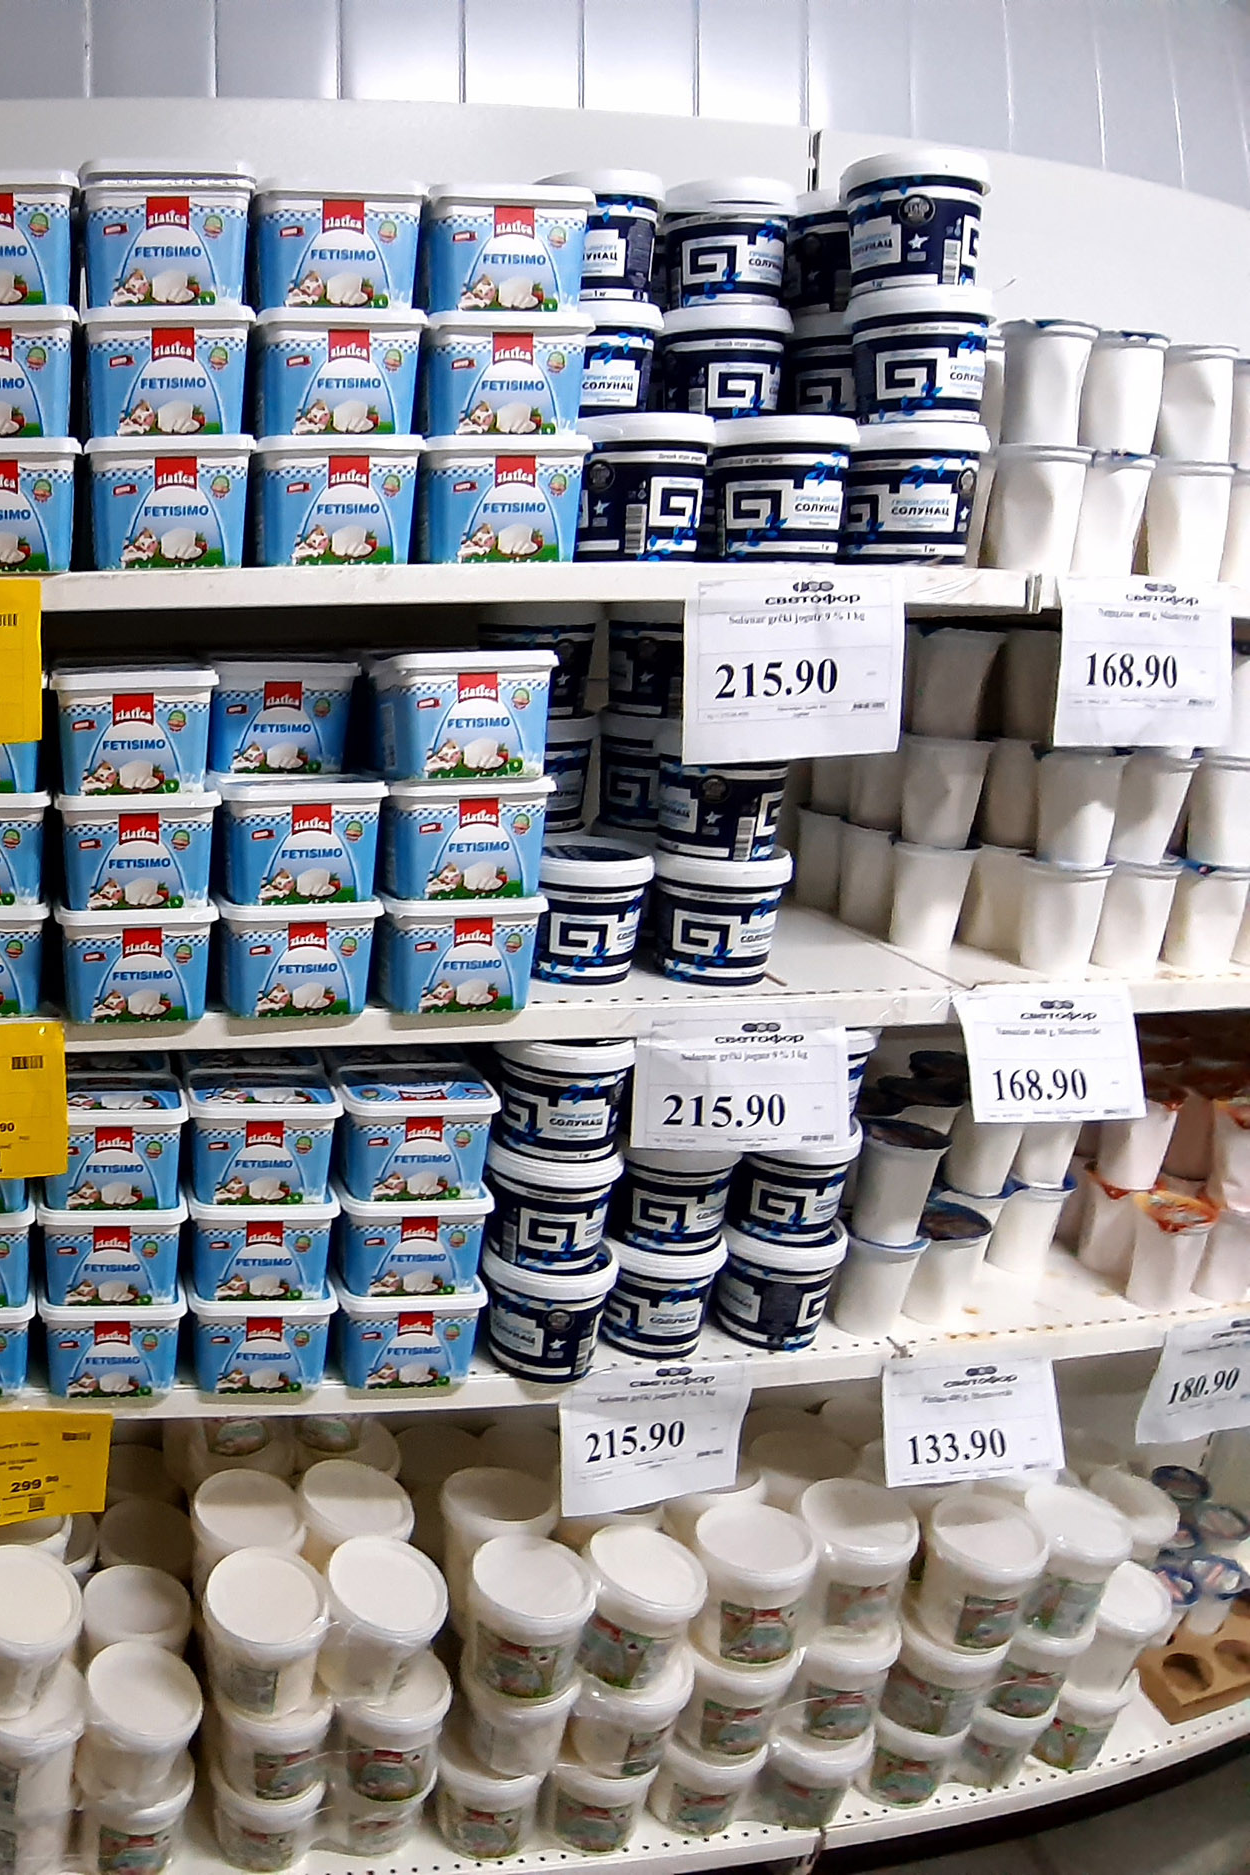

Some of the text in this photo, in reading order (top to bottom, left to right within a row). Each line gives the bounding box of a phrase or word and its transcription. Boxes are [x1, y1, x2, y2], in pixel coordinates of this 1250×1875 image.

[148, 209, 188, 226] zlatica
[324, 212, 364, 229] zlatica
[495, 219, 534, 236] zlatica
[133, 246, 201, 258] FETISIMO
[311, 249, 376, 261] FETISIMO
[583, 252, 617, 261] УНАЦ
[483, 254, 546, 265] FETISIMO
[153, 340, 193, 358] zlatica
[330, 342, 369, 358] zlatica
[494, 344, 532, 360] zlatica
[140, 378, 206, 389] FETISIMO
[317, 378, 381, 389] FETISIMO
[481, 380, 544, 391] FETISIMO
[582, 380, 634, 391] СОЛУНАЦ
[157, 469, 196, 486] zlatica
[330, 468, 368, 484] zlatica
[496, 468, 535, 485] zlatica
[144, 505, 209, 517] FETISIMO
[317, 504, 379, 515] FETISIMO
[483, 503, 546, 513] FETISIMO
[891, 506, 950, 517] СОЛУНАЦ
[1086, 652, 1178, 688] 168.90
[715, 658, 838, 700] 215.90
[459, 685, 497, 700] zlatica
[265, 693, 300, 708] zlatica
[115, 706, 152, 721] zlatica
[253, 724, 311, 733] FETISIMO
[447, 717, 510, 728] FETISIMO
[103, 739, 165, 750] FETISIMO
[294, 817, 330, 831] zlatica
[461, 811, 498, 825] zlatica
[120, 825, 158, 841] zlatica
[449, 841, 509, 853] FETISIMO
[281, 848, 342, 859] FETISIMO
[109, 858, 170, 869] FETISIMO
[290, 934, 325, 947] zlatica
[456, 930, 491, 944] zlatica
[124, 939, 160, 954] zlatica
[278, 963, 337, 974] FETISIMO
[443, 960, 502, 971] FETISIMO
[113, 970, 173, 981] FETISIMO
[992, 1068, 1087, 1101] 168.90
[662, 1093, 786, 1128] 215.90
[0, 1122, 15, 1132] 90
[550, 1117, 603, 1126] СОЛУНАЦ
[234, 1159, 293, 1169] FETISIMO
[394, 1154, 451, 1165] FETISIMO
[86, 1164, 144, 1174] FETISIMO
[235, 1258, 292, 1267] FETISIMO
[390, 1253, 446, 1263] FETISIMO
[84, 1264, 140, 1274] FETISIMO
[235, 1352, 291, 1362] FETISIMO
[387, 1346, 442, 1356] FETISIMO
[85, 1356, 140, 1366] FETISIMO
[1167, 1367, 1240, 1405] 180.90
[585, 1420, 685, 1464] 215.90
[908, 1428, 1006, 1465] 133.90
[11, 1478, 42, 1493] 299
